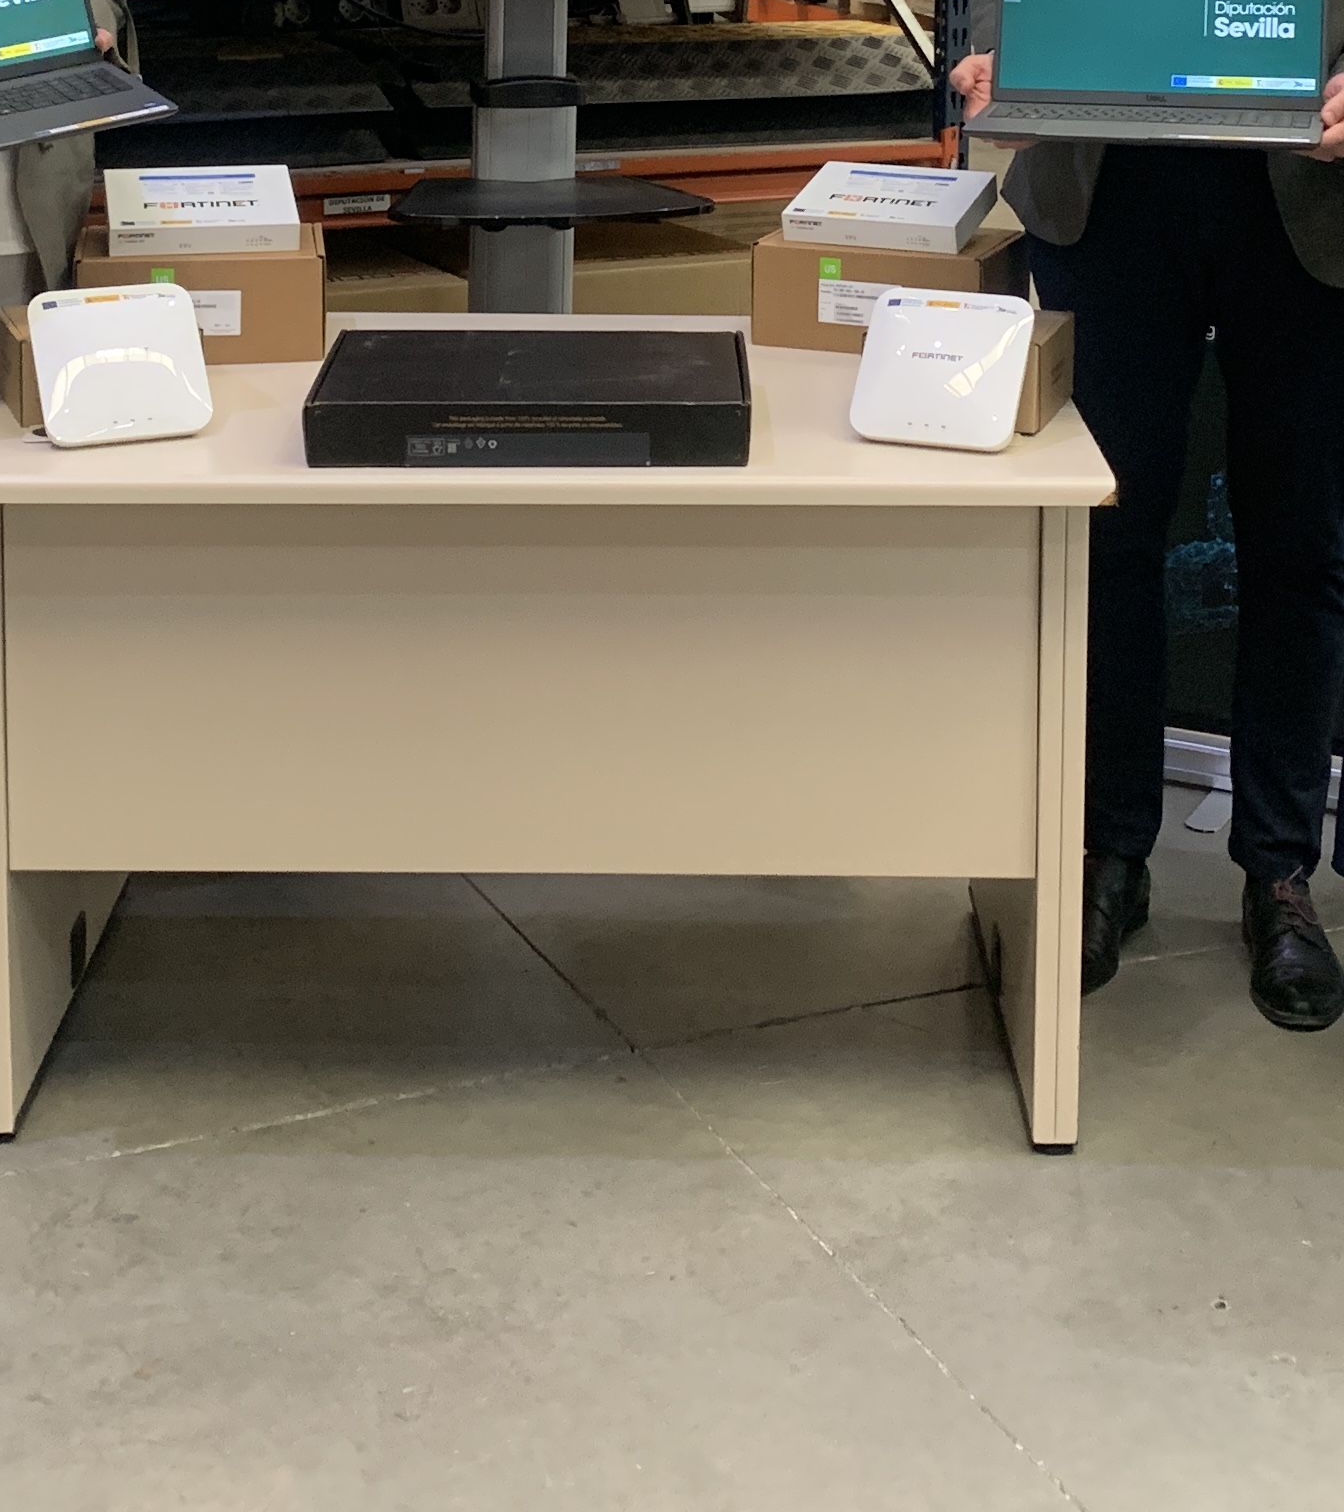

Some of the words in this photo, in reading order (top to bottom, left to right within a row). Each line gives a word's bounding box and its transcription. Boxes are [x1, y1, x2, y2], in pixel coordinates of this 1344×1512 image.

[1214, 0, 1296, 17] Diputación
[1214, 16, 1296, 39] Sevilla
[143, 199, 259, 209] FORTINET
[828, 192, 939, 208] FORTINET
[824, 264, 836, 274] US
[911, 351, 964, 363] FORTINET
